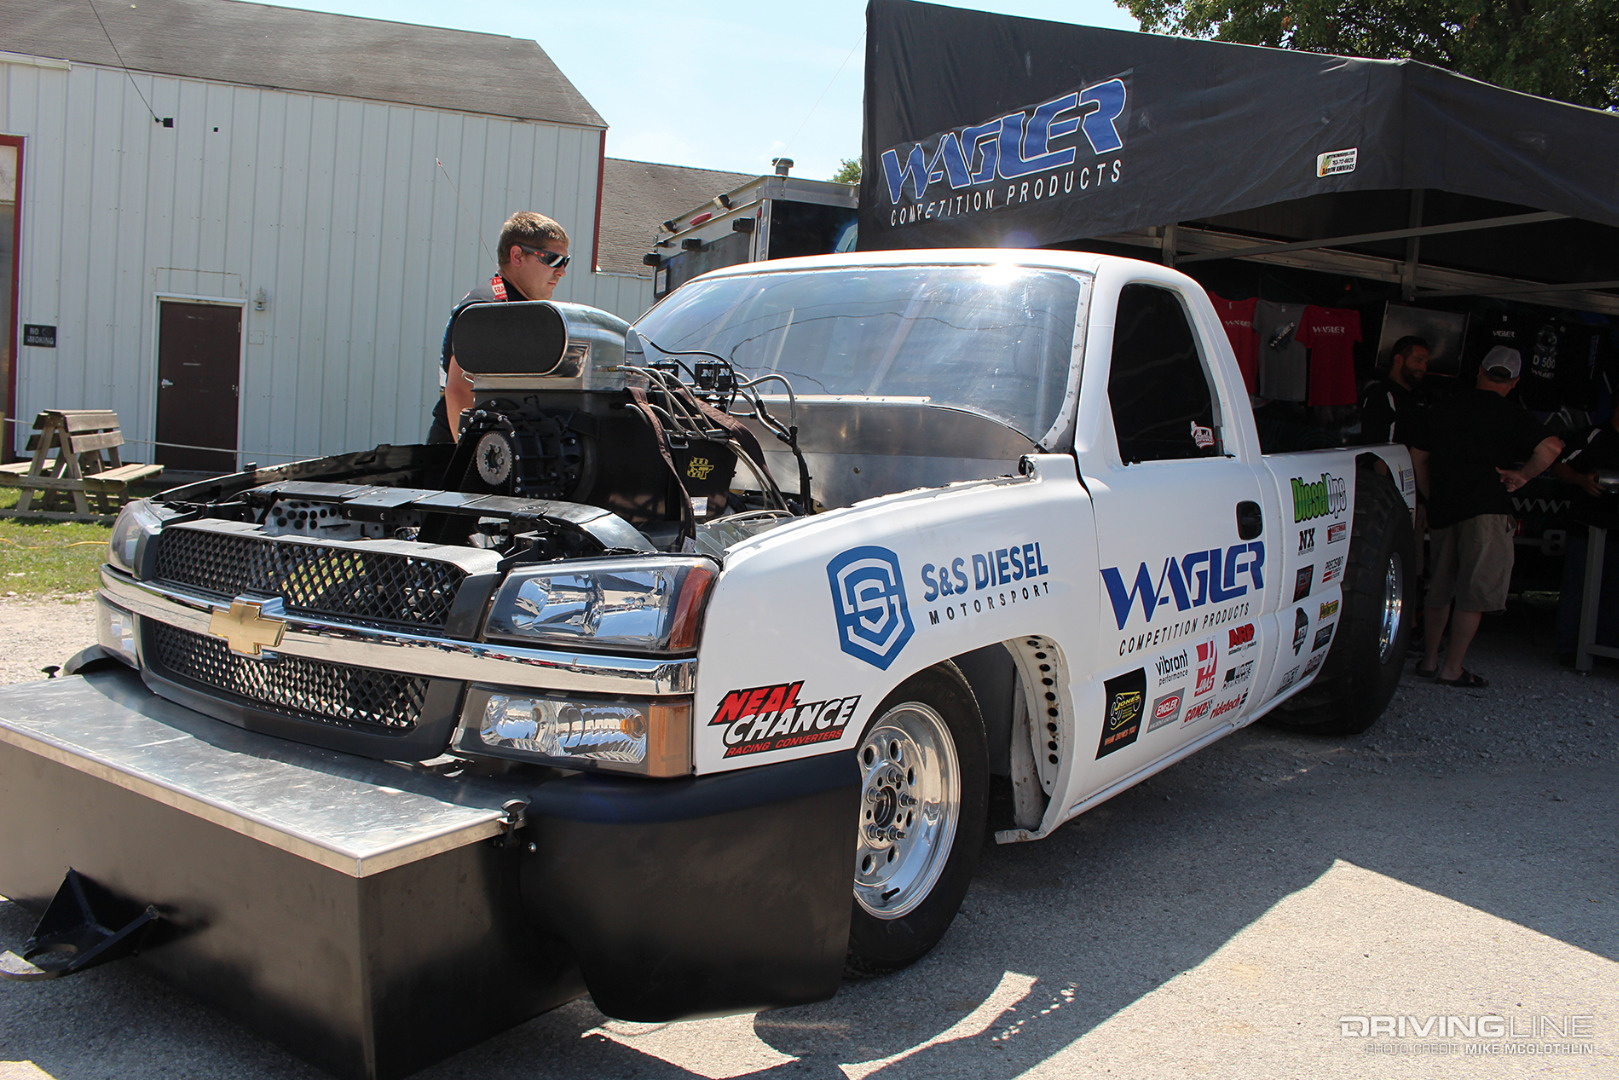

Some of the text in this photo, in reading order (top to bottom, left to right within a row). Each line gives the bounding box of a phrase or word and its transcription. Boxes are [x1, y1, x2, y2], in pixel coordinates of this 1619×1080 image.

[881, 78, 1127, 204] WAGLER
[890, 159, 1123, 227] COMPETITION PRODUCTS
[1291, 473, 1347, 523] DieselOps
[1298, 528, 1316, 551] NX
[921, 542, 1049, 602] S&S DIESEL
[1100, 541, 1265, 630] WAGLER
[929, 582, 1050, 625] MOTORSPORT
[1119, 618, 1198, 656] COMPETITION
[1202, 602, 1250, 629] PRODUCTS
[1228, 623, 1255, 649] ARP
[1155, 649, 1188, 676] vibrant
[1158, 669, 1188, 687] performance
[713, 683, 802, 723] NEAL
[724, 696, 858, 745] CHANCE
[1114, 694, 1141, 711] JONES
[1210, 694, 1241, 719] ridetech
[726, 729, 844, 757] RACING CONVERTERS
